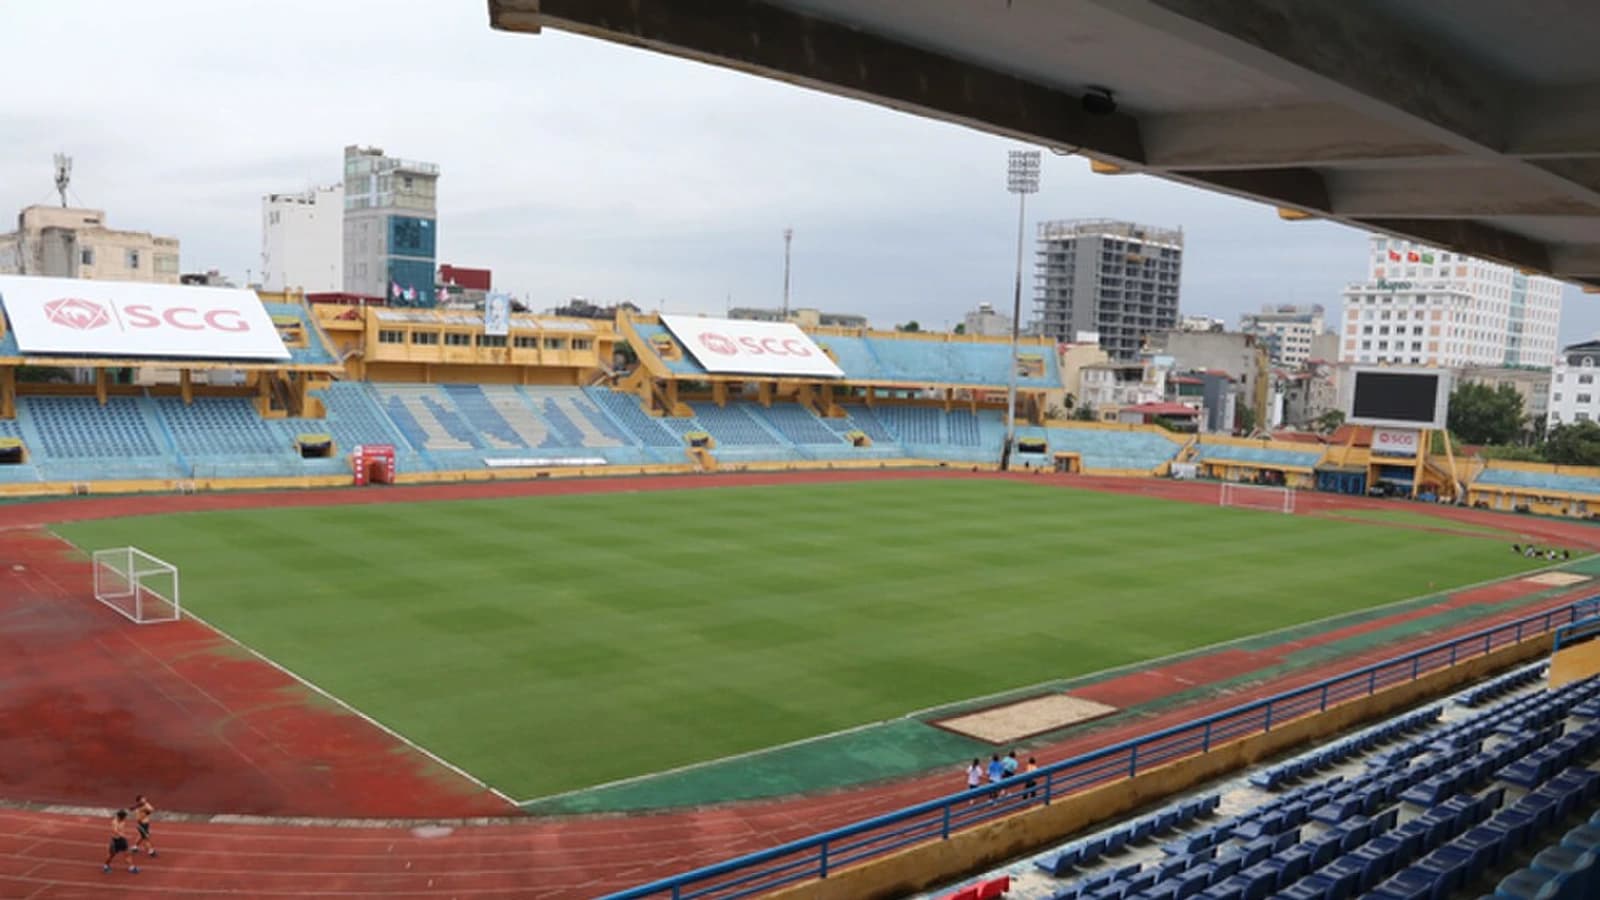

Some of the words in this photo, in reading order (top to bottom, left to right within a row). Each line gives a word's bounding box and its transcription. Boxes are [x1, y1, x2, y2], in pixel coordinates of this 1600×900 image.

[124, 305, 250, 332] SCG
[739, 337, 813, 356] SCG
[1391, 434, 1412, 445] SCG
